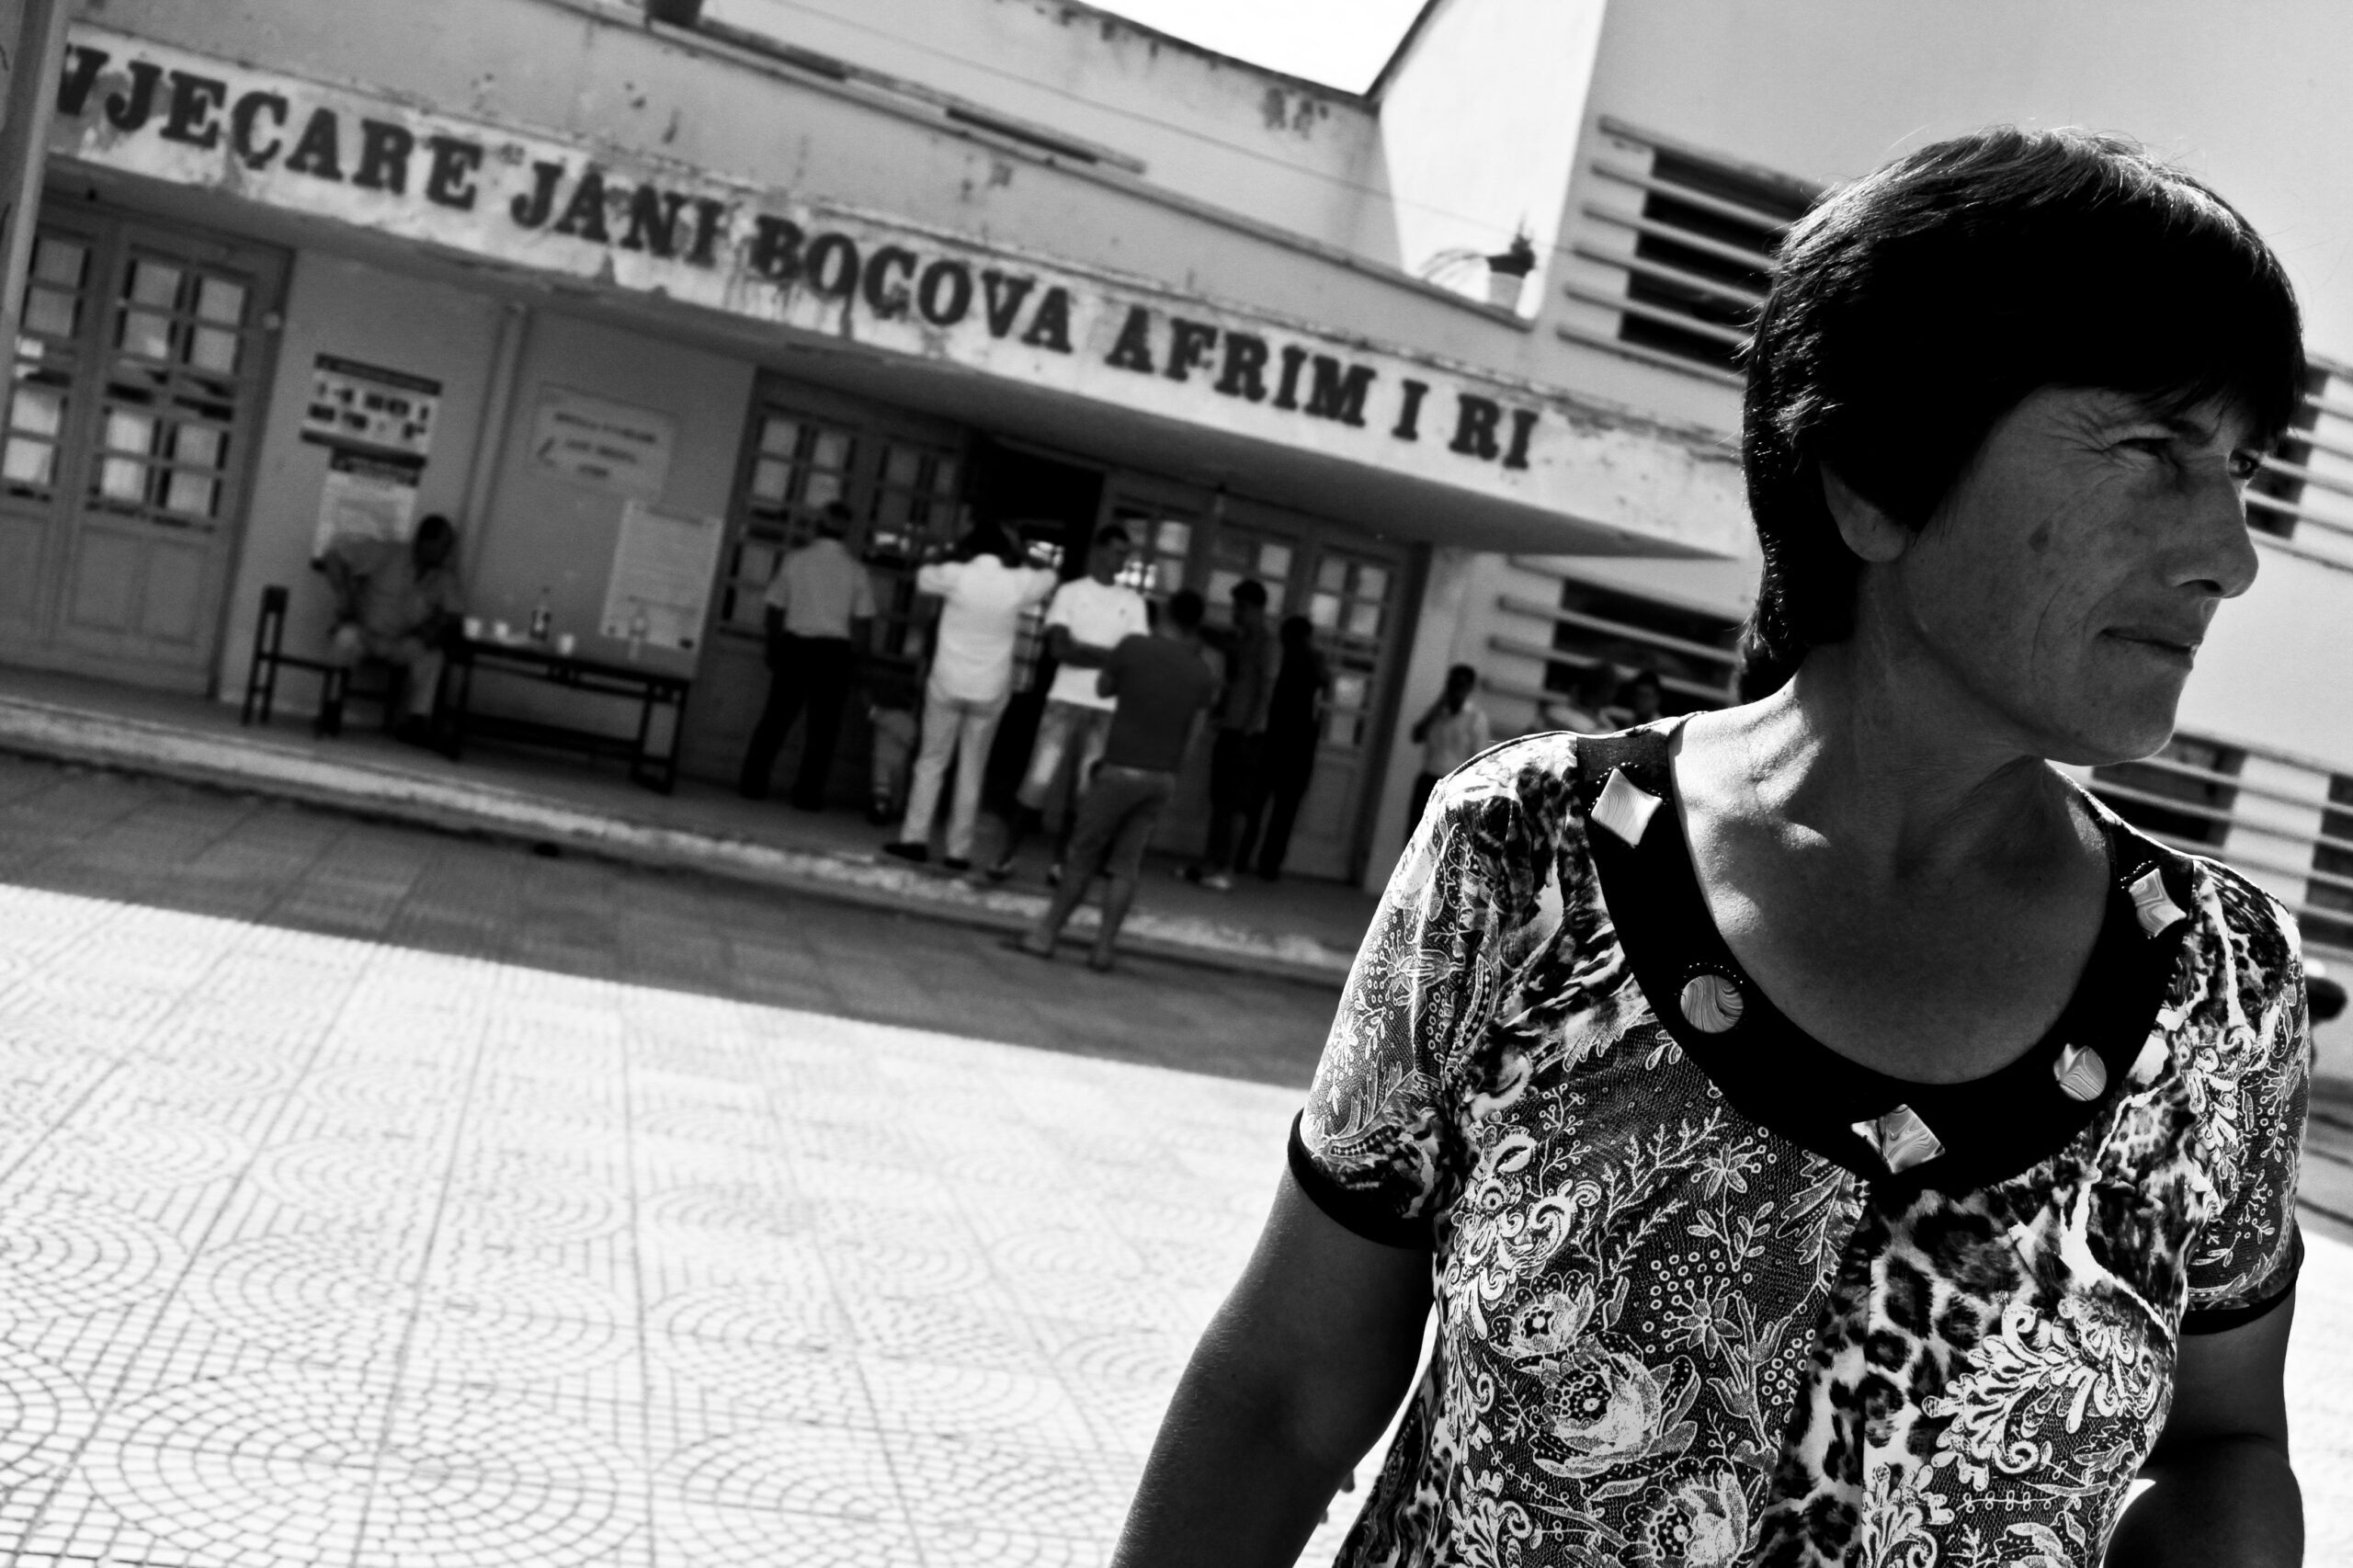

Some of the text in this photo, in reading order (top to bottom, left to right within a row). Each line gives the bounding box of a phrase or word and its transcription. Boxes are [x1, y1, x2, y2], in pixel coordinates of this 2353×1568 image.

[510, 160, 724, 269] JANI
[1104, 303, 1377, 428] AFRIM
[1392, 378, 1429, 442] I
[1449, 392, 1540, 471] RI
